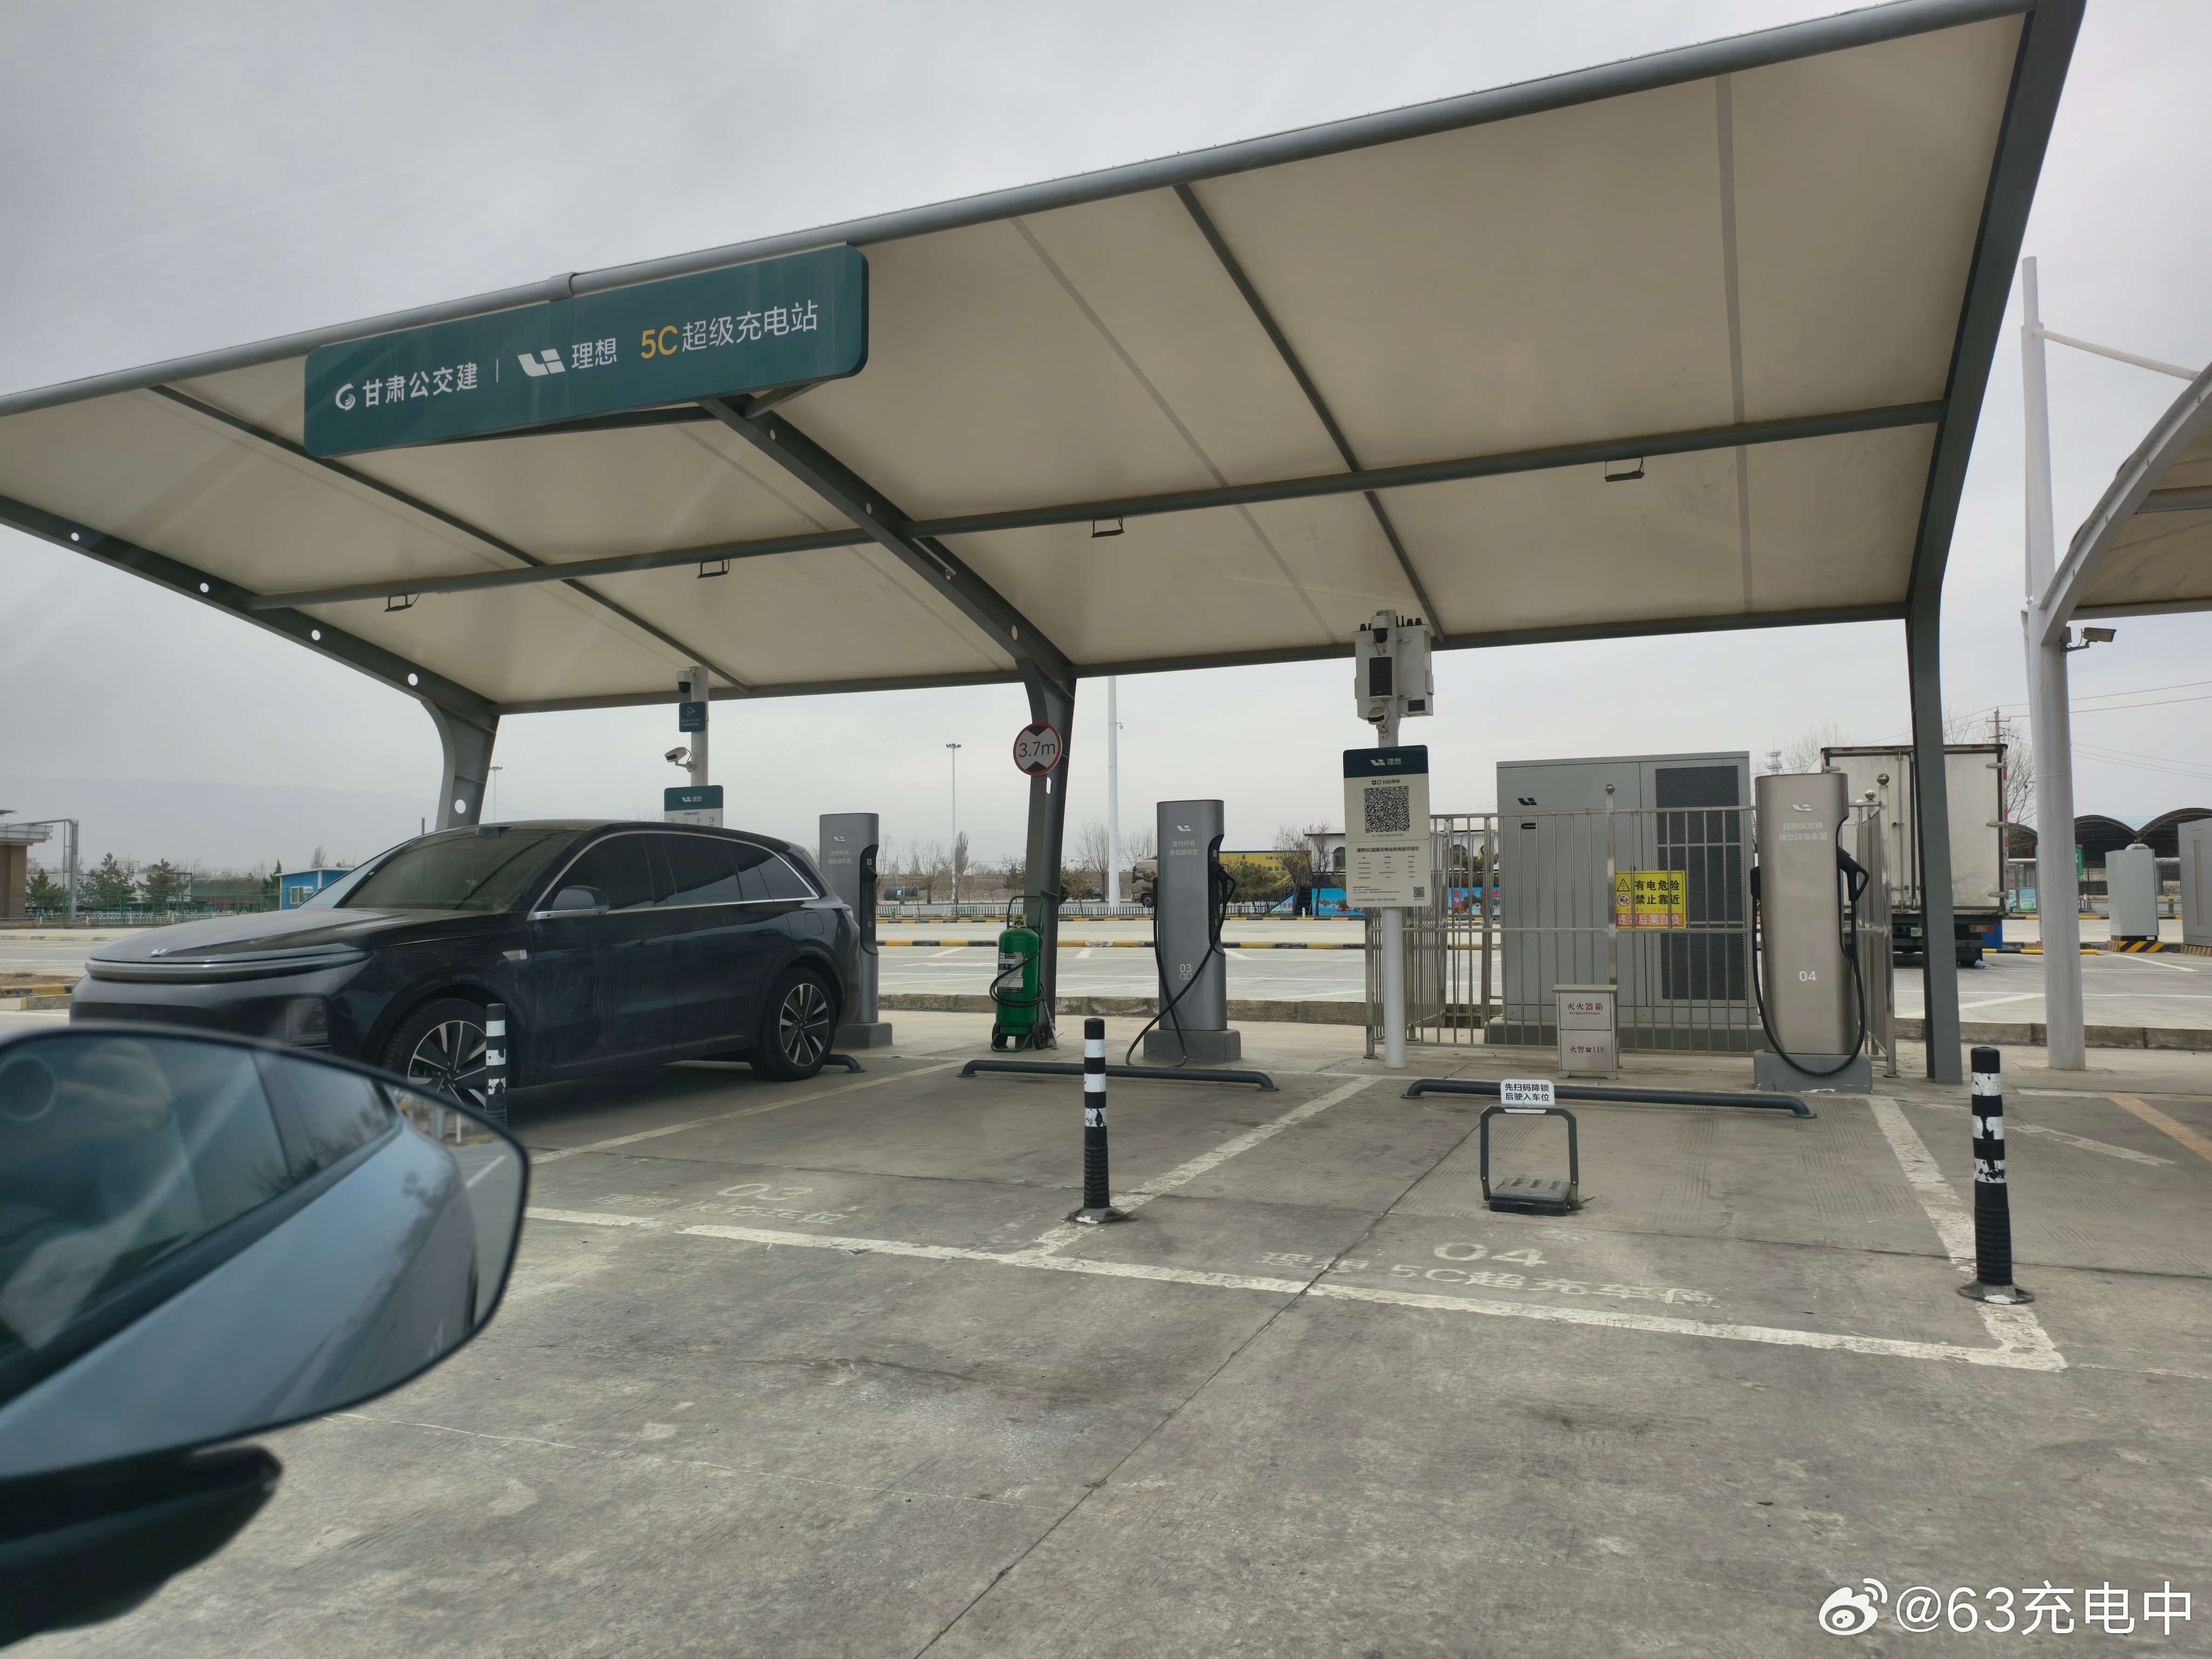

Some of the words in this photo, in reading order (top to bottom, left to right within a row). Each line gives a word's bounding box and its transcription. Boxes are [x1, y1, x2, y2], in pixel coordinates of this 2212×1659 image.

[362, 362, 478, 407] 甘肃公交建
[571, 338, 617, 370] 理想
[640, 300, 818, 360] 5C超级充电站
[1019, 741, 1055, 758] 3.7m
[1783, 822, 1823, 831] 目前仅支持
[1779, 832, 1828, 841] 理想纯电车型
[1635, 880, 1680, 891] 有电危险
[1635, 894, 1681, 905] 禁止靠近
[1179, 963, 1192, 973] 03
[1799, 970, 1817, 981] 04
[1567, 1002, 1603, 1011] 灭火器箱
[1505, 1083, 1549, 1092] 先扫码降锁
[1505, 1092, 1550, 1101] 后驶入车位
[1433, 1242, 1548, 1267] 04
